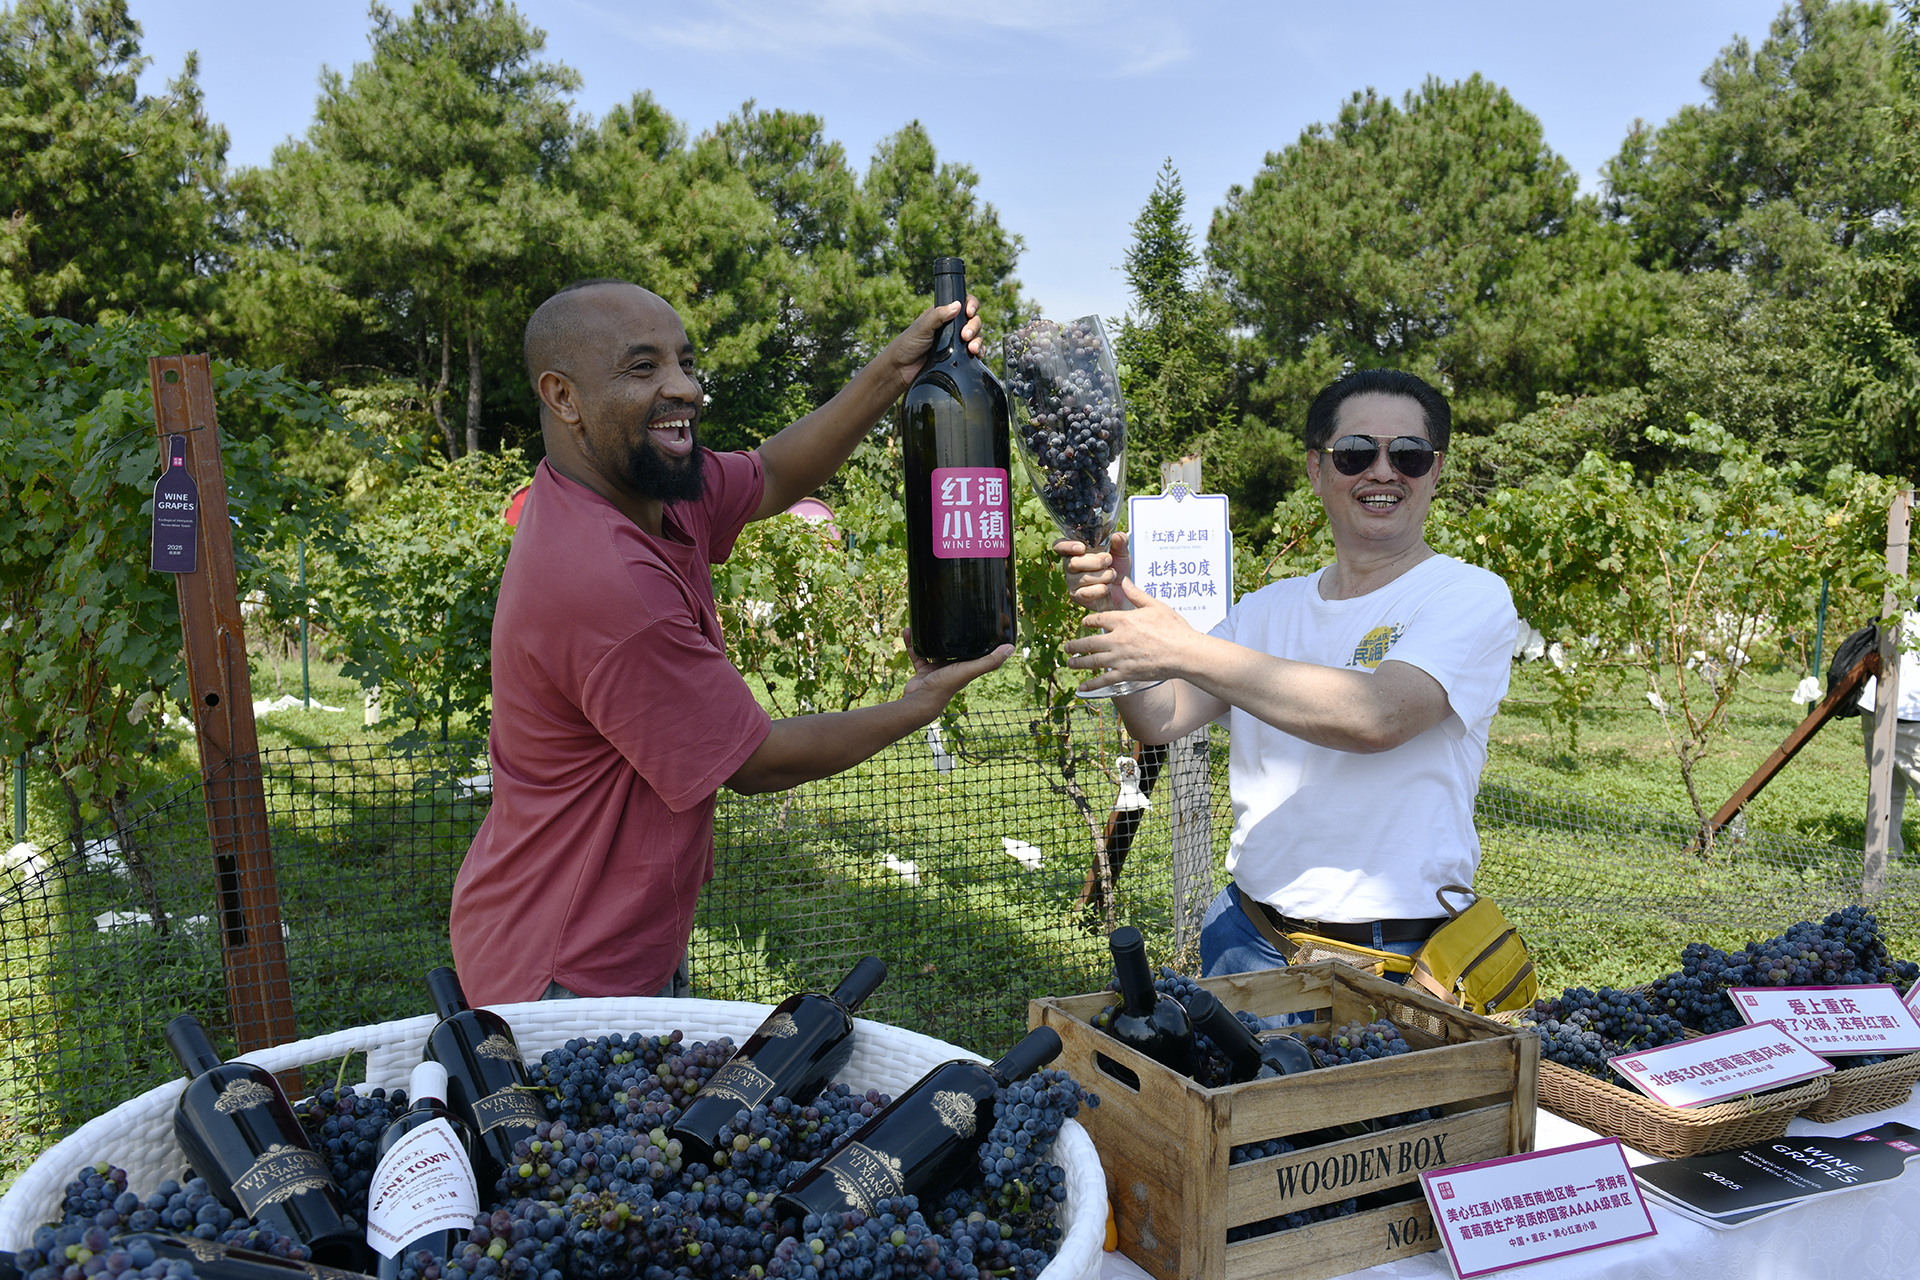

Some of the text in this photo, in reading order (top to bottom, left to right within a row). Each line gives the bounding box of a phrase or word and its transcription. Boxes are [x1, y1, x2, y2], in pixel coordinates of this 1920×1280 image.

[164, 492, 188, 501] WINE
[941, 477, 1003, 506] 红酒
[158, 501, 195, 511] GRAPES
[942, 510, 1004, 539] 小镇
[1152, 529, 1209, 543] 红酒产业园
[942, 540, 1005, 549] WINE TOWN
[1147, 559, 1211, 577] 北纬30度
[1144, 580, 1217, 599] 葡萄酒风味
[1787, 998, 1861, 1016] 爱上重庆
[732, 1067, 766, 1089] TOWN
[1649, 1042, 1797, 1087] 北纬30度葡萄酒风味
[481, 1096, 517, 1111] WINE
[494, 1105, 504, 1113] LI
[850, 1147, 880, 1174] WINE
[879, 1173, 897, 1198] TO
[1276, 1133, 1448, 1200] WOODEN BOX
[1772, 1144, 1859, 1184] GRAPES
[1803, 1146, 1864, 1174] WINE
[241, 1162, 281, 1190] WINE
[255, 1177, 267, 1190] LI
[269, 1163, 305, 1180] XIANG
[373, 1174, 406, 1211] WINE
[404, 1152, 451, 1174] TOWN
[849, 1158, 860, 1168] LI
[859, 1166, 885, 1197] XIANG
[1702, 1171, 1743, 1191] 2025
[1446, 1174, 1628, 1223] 美心红酒小镇是西南地区唯一一家拥有
[1458, 1192, 1633, 1241] 葡萄酒生产资质的国家AAAA级景区
